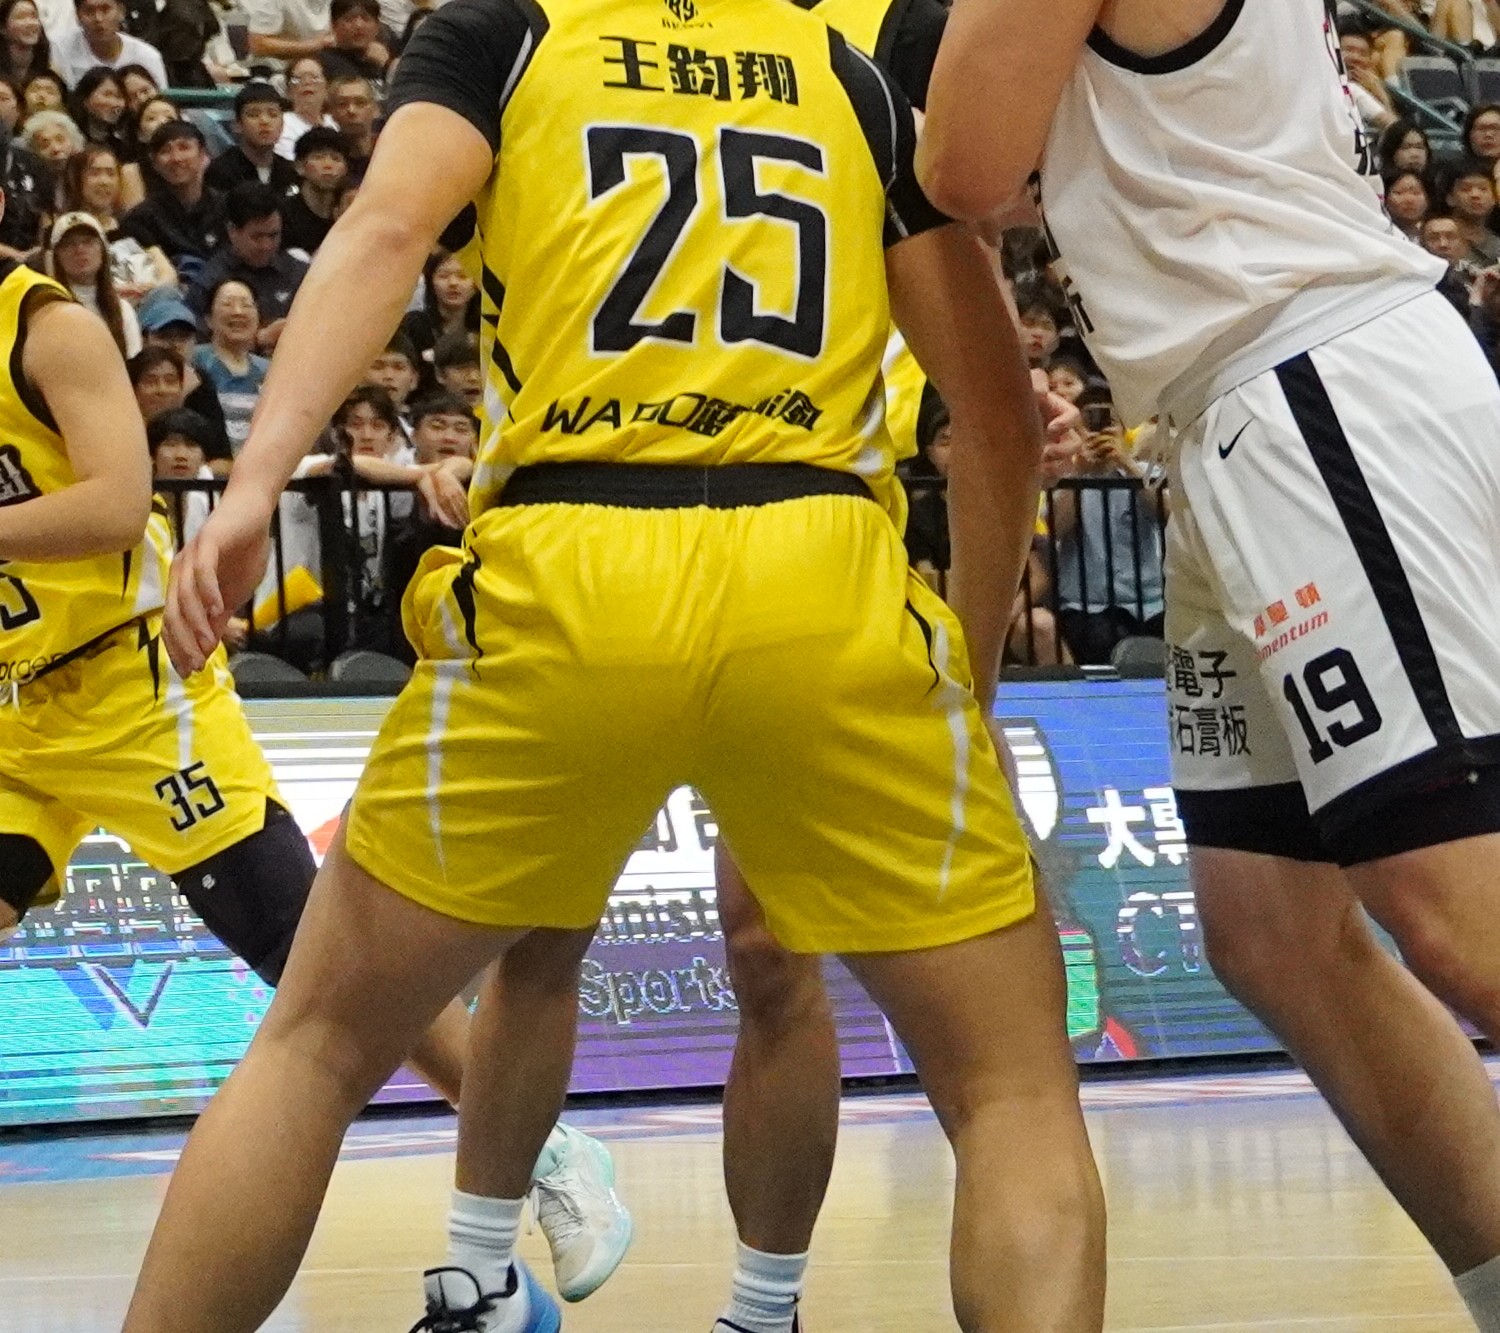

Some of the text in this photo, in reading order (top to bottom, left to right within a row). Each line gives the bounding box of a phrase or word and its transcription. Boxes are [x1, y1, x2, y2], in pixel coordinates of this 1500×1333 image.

[584, 122, 829, 361] 25
[1255, 611, 1330, 661] mentum
[1170, 644, 1237, 699] 電子
[1173, 704, 1252, 757] 石膏板
[1283, 646, 1383, 765] 19
[155, 760, 227, 832] 35
